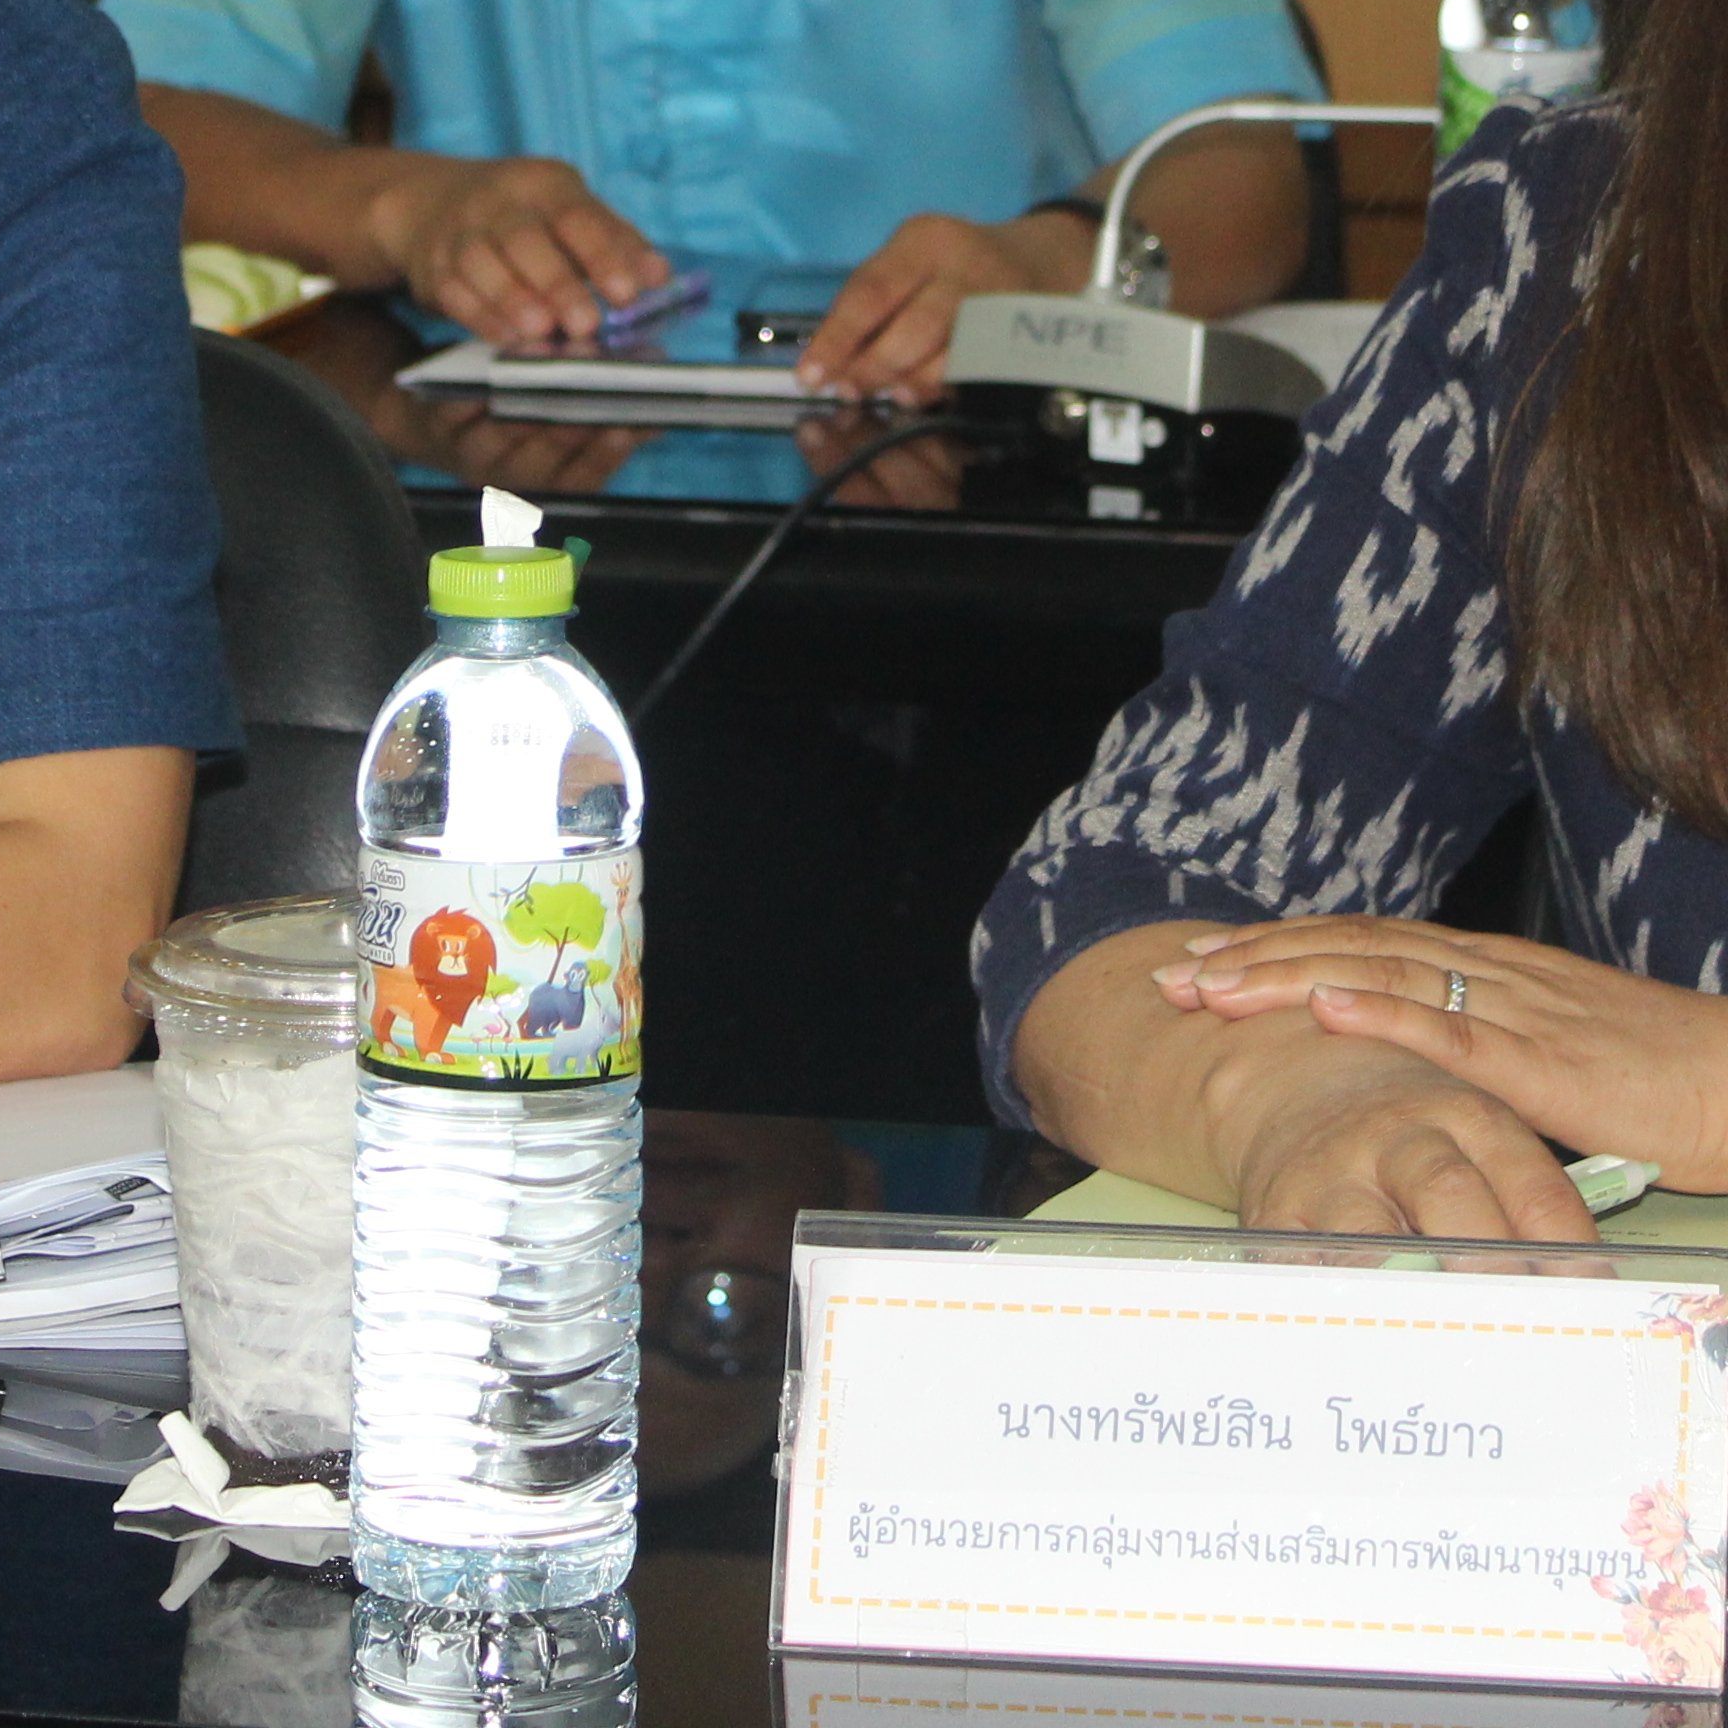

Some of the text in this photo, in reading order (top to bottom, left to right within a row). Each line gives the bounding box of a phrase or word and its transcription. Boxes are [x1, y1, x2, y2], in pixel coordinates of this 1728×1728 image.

[1011, 310, 1129, 356] NPE
[997, 1392, 1503, 1460] นางทรัพย์สิน โพธ์ขาว
[848, 1501, 1647, 1591] ผู้อำนวยการกลุ่มงานส่งเสริมการพัฒนาชุมชน
